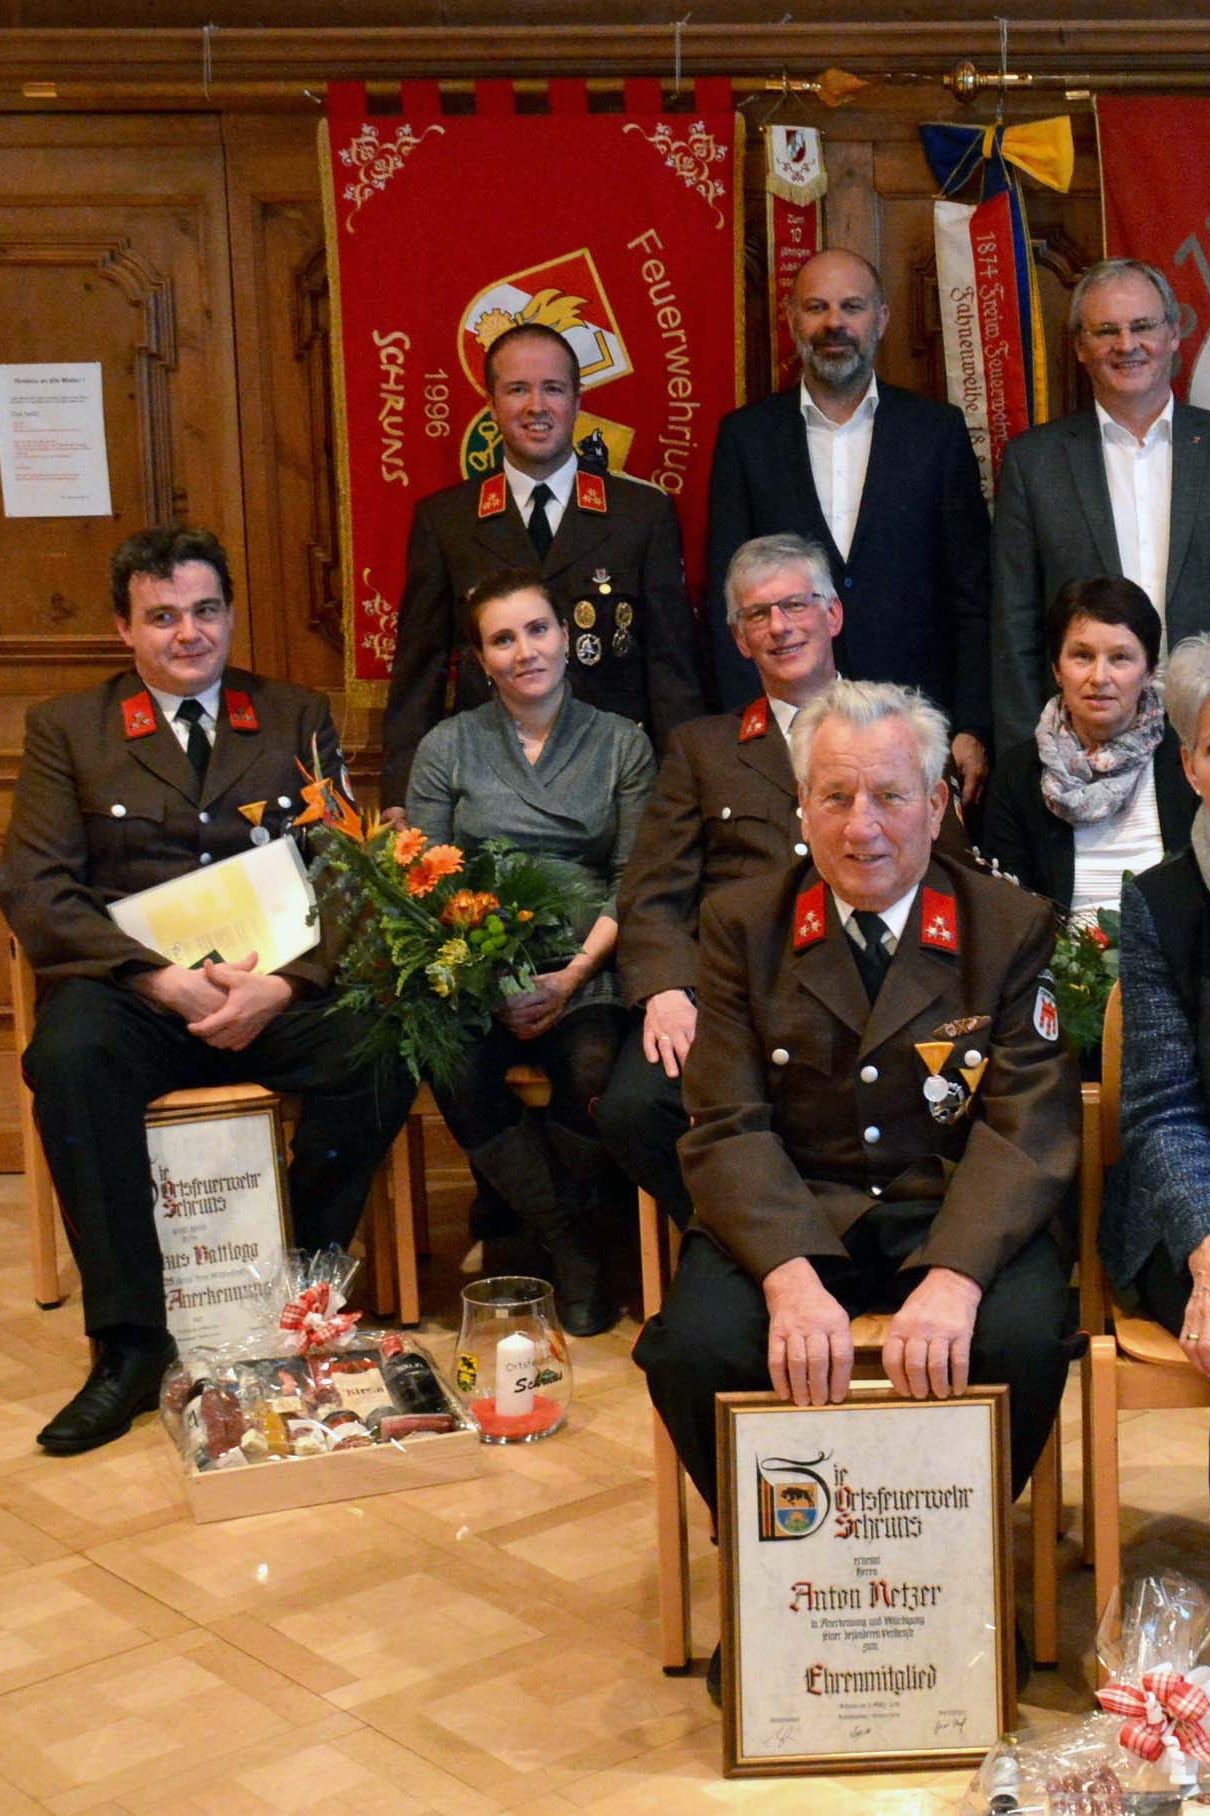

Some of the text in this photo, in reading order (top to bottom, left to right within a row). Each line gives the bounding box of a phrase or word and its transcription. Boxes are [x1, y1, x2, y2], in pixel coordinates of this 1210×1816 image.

[976, 232, 999, 279] 1874
[372, 329, 411, 487] SCHRUNS
[424, 368, 450, 438] 1996
[161, 1172, 261, 1200] Ortsfeuerwehr
[163, 1197, 227, 1218] Schruns
[834, 1485, 975, 1514] Ortsfeuerwehr
[834, 1513, 923, 1543] Schruns
[789, 1580, 943, 1612] Anton Netzer
[805, 1663, 938, 1697] Ehrenmitglied
